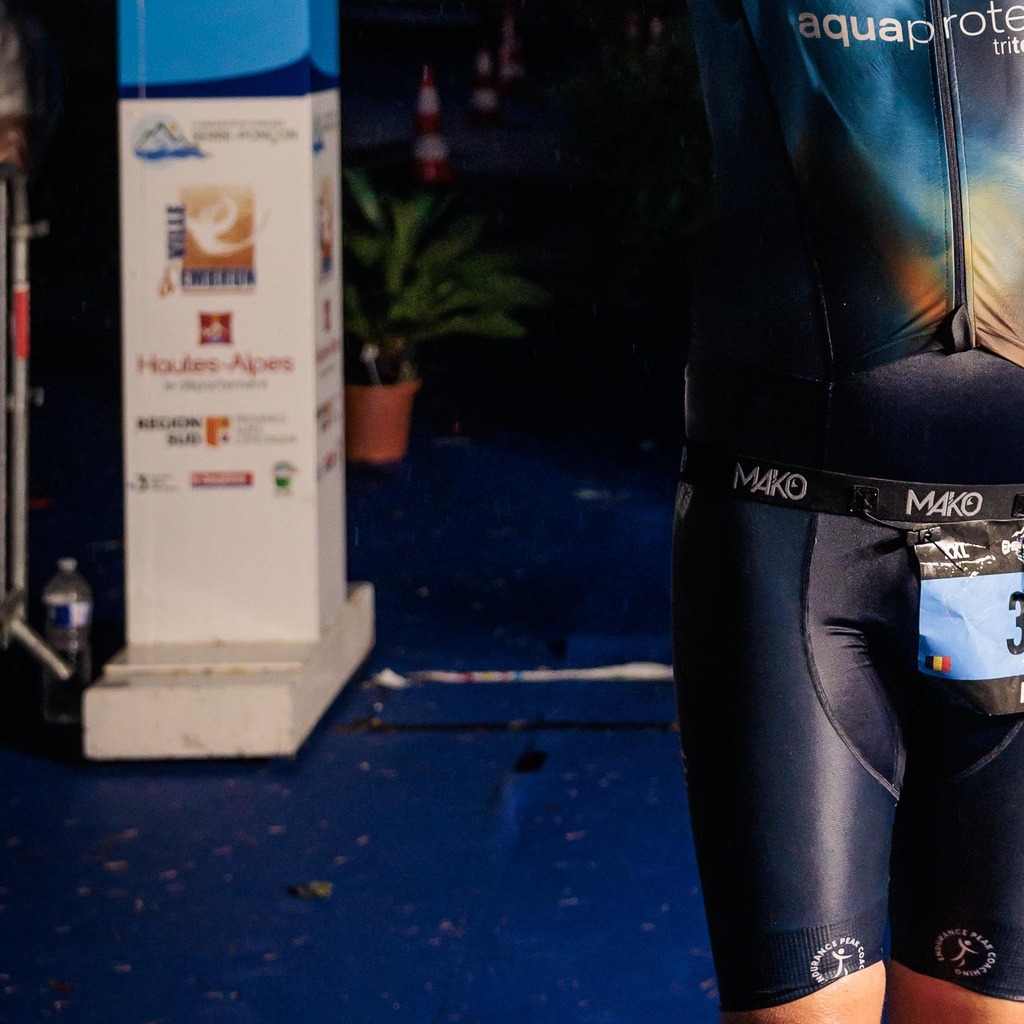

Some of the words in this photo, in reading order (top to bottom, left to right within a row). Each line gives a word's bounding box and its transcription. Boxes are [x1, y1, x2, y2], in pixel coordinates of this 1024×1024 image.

[733, 462, 808, 501] MAKO
[906, 489, 984, 517] MAKO
[810, 940, 838, 984] NDURANCE
[840, 937, 860, 948] PEAK
